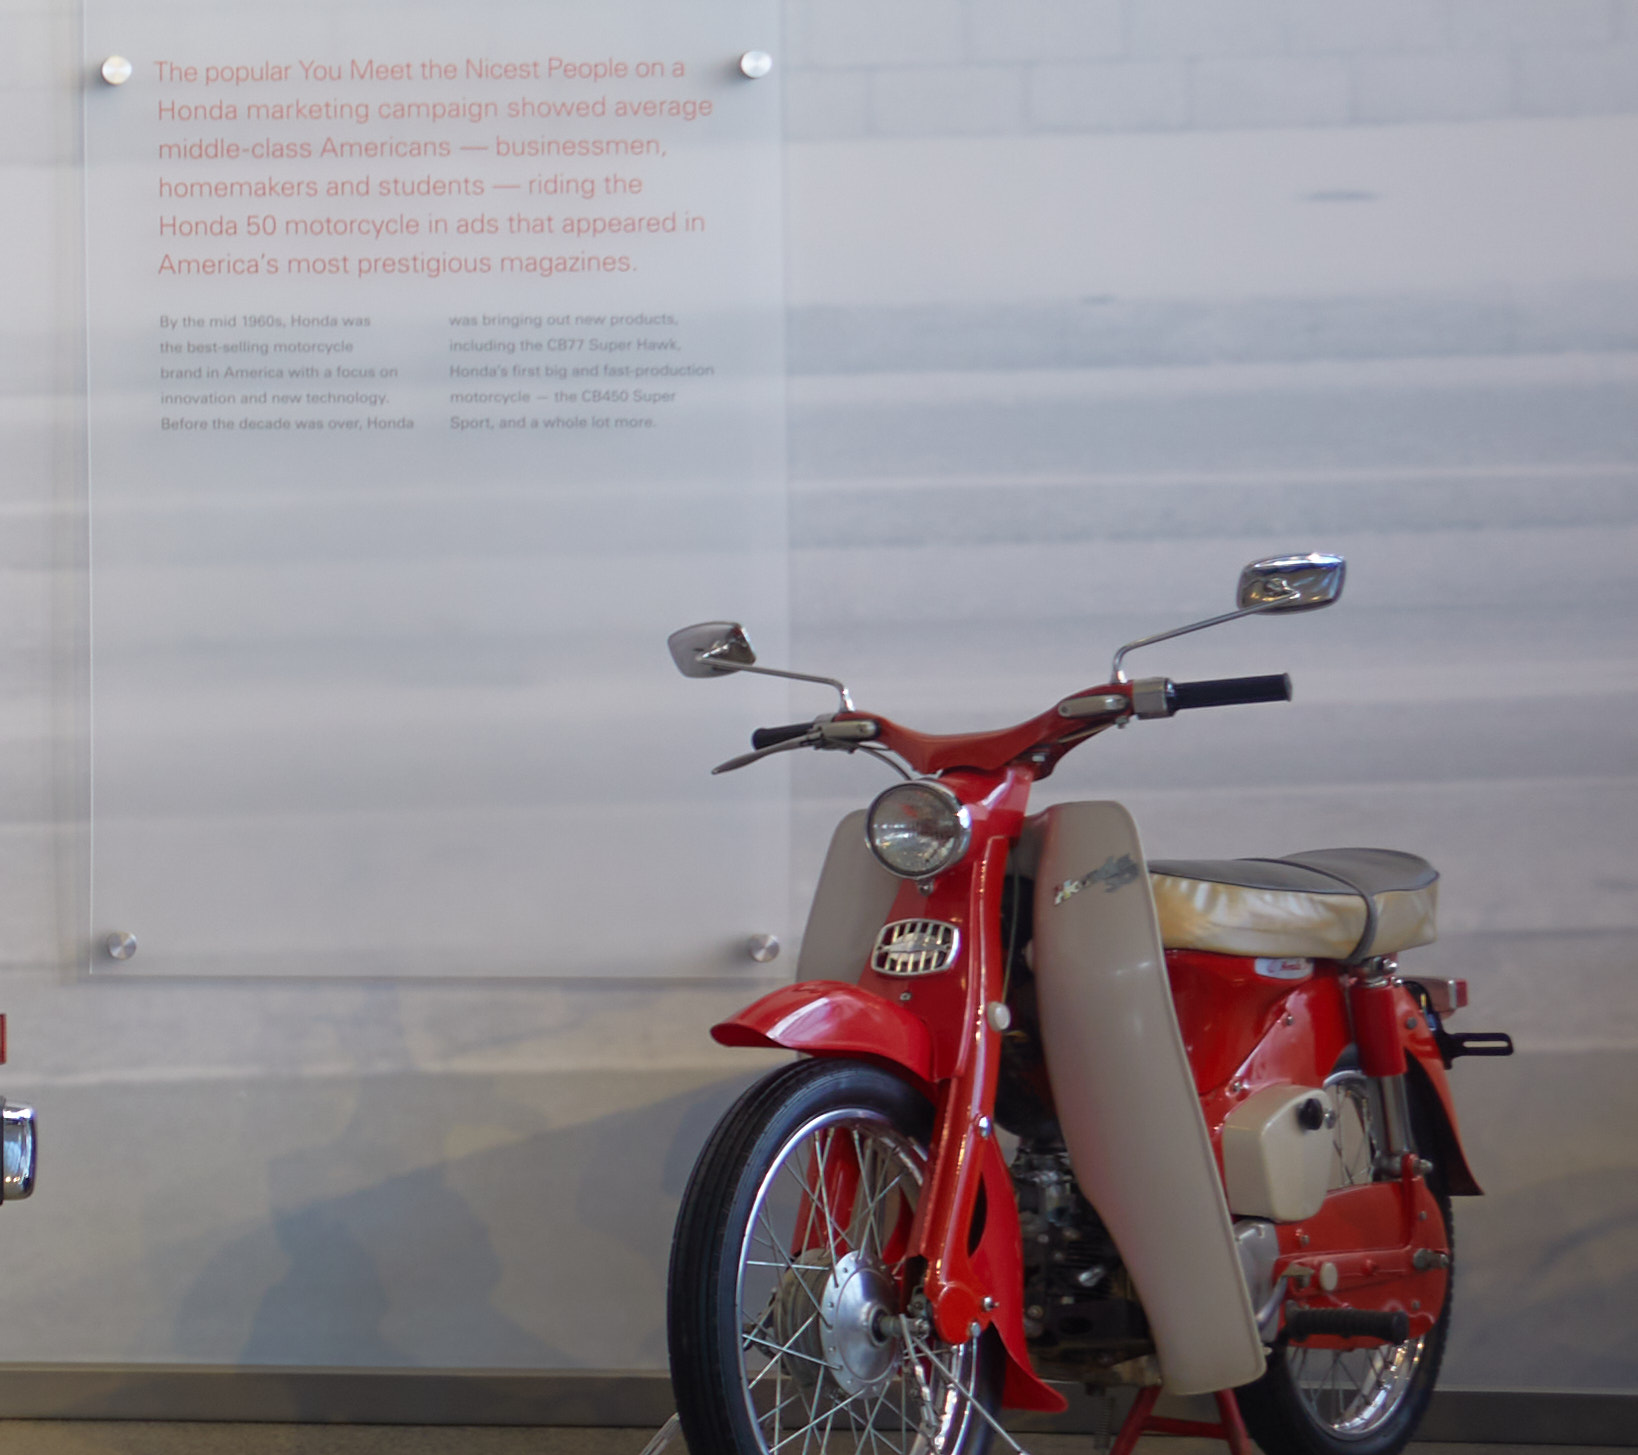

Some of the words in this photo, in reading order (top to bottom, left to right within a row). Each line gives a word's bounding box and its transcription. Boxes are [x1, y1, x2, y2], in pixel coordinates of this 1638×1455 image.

[156, 61, 197, 82] The
[206, 62, 290, 86] popular
[300, 61, 342, 81] You
[351, 60, 411, 80] Meet
[421, 61, 457, 79] the
[466, 59, 539, 79] Nicest
[548, 58, 628, 82] People
[636, 62, 664, 78] on
[672, 62, 685, 77] a
[158, 100, 238, 121] Honda
[247, 100, 369, 124] marketing
[378, 102, 498, 123] campaign
[508, 96, 606, 118] showed
[615, 100, 713, 121] average
[160, 316, 177, 329] By
[183, 317, 204, 327] the
[210, 317, 236, 327] mid
[291, 316, 338, 327] Honda
[343, 318, 370, 326] was
